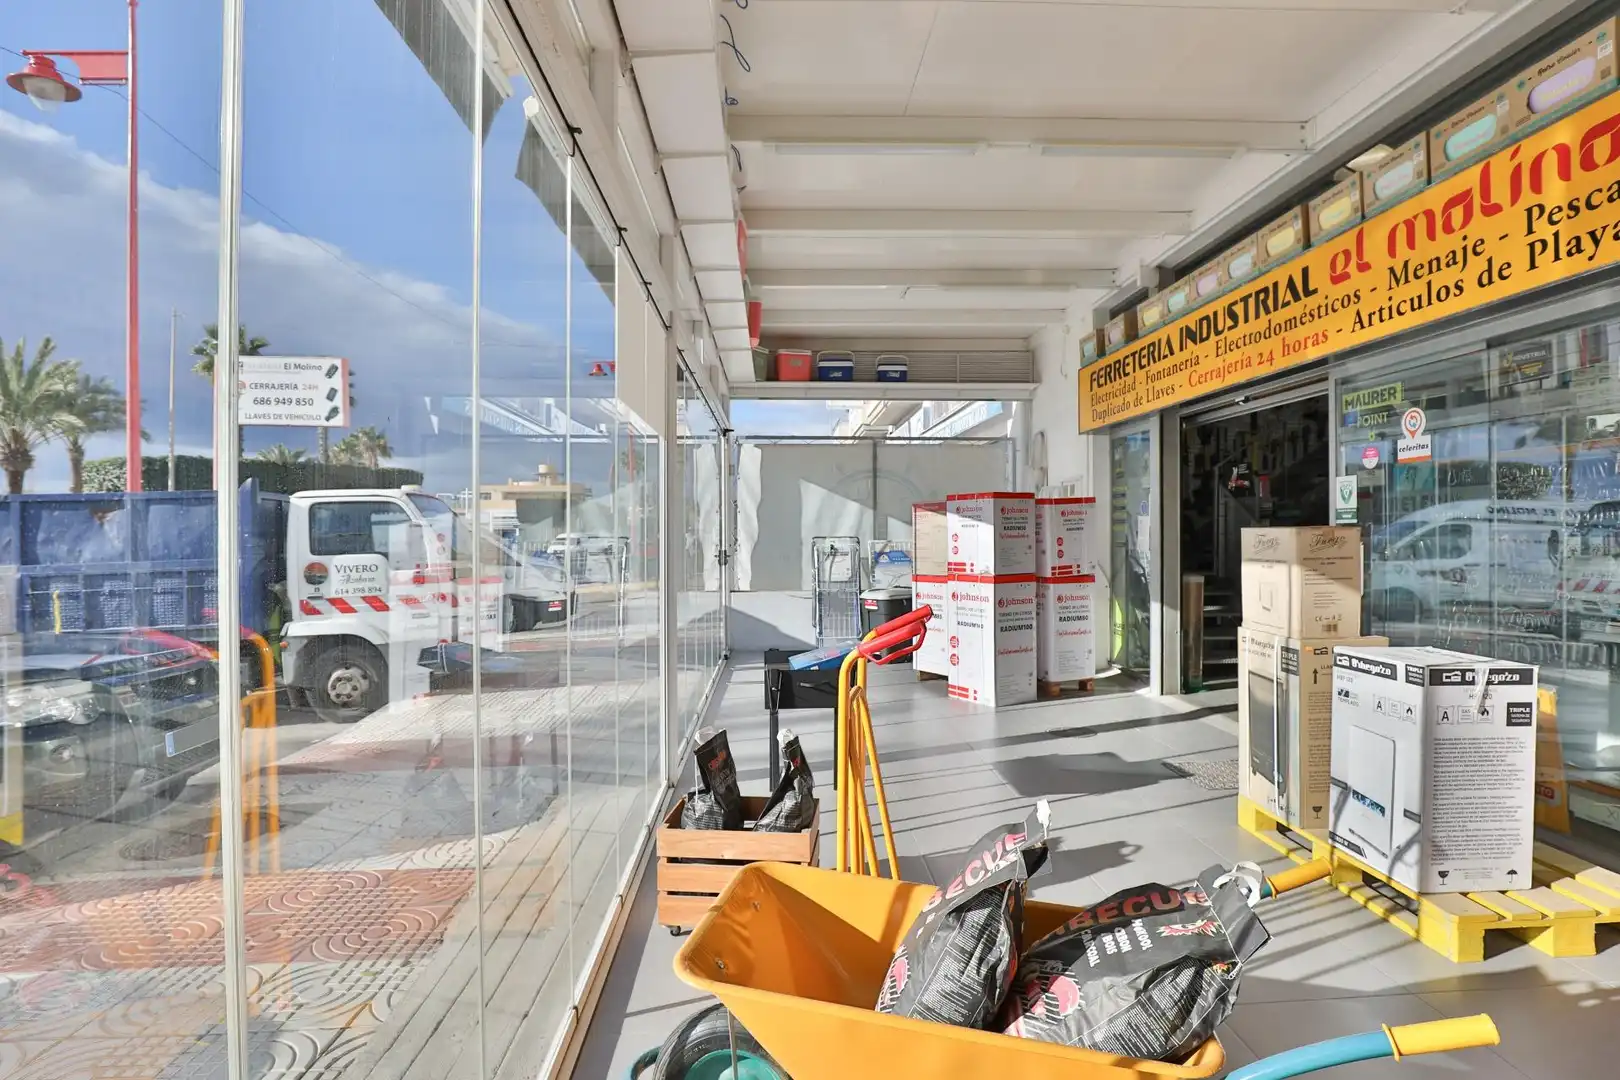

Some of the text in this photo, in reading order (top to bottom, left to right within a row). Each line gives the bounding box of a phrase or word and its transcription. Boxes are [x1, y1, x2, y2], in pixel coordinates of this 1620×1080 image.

[1090, 113, 1620, 392] FERRETERIA INDUSTRIAL el molino
[1091, 379, 1137, 407] Electricidad
[1145, 351, 1201, 386] Fontanería
[1215, 288, 1361, 358] Electrodomésticos
[1387, 235, 1485, 291] Menaje
[1524, 179, 1620, 237] Pesca
[1092, 398, 1131, 423] Duplicado
[1133, 393, 1144, 408] de
[1146, 384, 1176, 404] Llaves
[1188, 353, 1252, 388] Cerrajería
[1256, 350, 1275, 368] 24
[1281, 329, 1329, 358] horas
[1351, 274, 1464, 333] Articulos
[1477, 257, 1512, 289] de
[283, 362, 292, 371] El
[294, 362, 323, 371] Molino
[249, 382, 319, 391] CERRAJERÍA 24H
[253, 396, 314, 406] 686 949 850
[1344, 386, 1397, 410] MAURER
[244, 412, 272, 420] LLAVES
[1357, 411, 1389, 428] POINT
[1398, 443, 1429, 453] celeritas
[335, 563, 379, 574] VIVERO
[334, 584, 382, 596] 614 398 894
[959, 591, 990, 603] johnson
[1005, 597, 1034, 607] johnson
[1000, 623, 1033, 632] RADIUM100
[1376, 700, 1383, 711] A
[1441, 710, 1449, 722] A
[1102, 934, 1118, 955] BOIS
